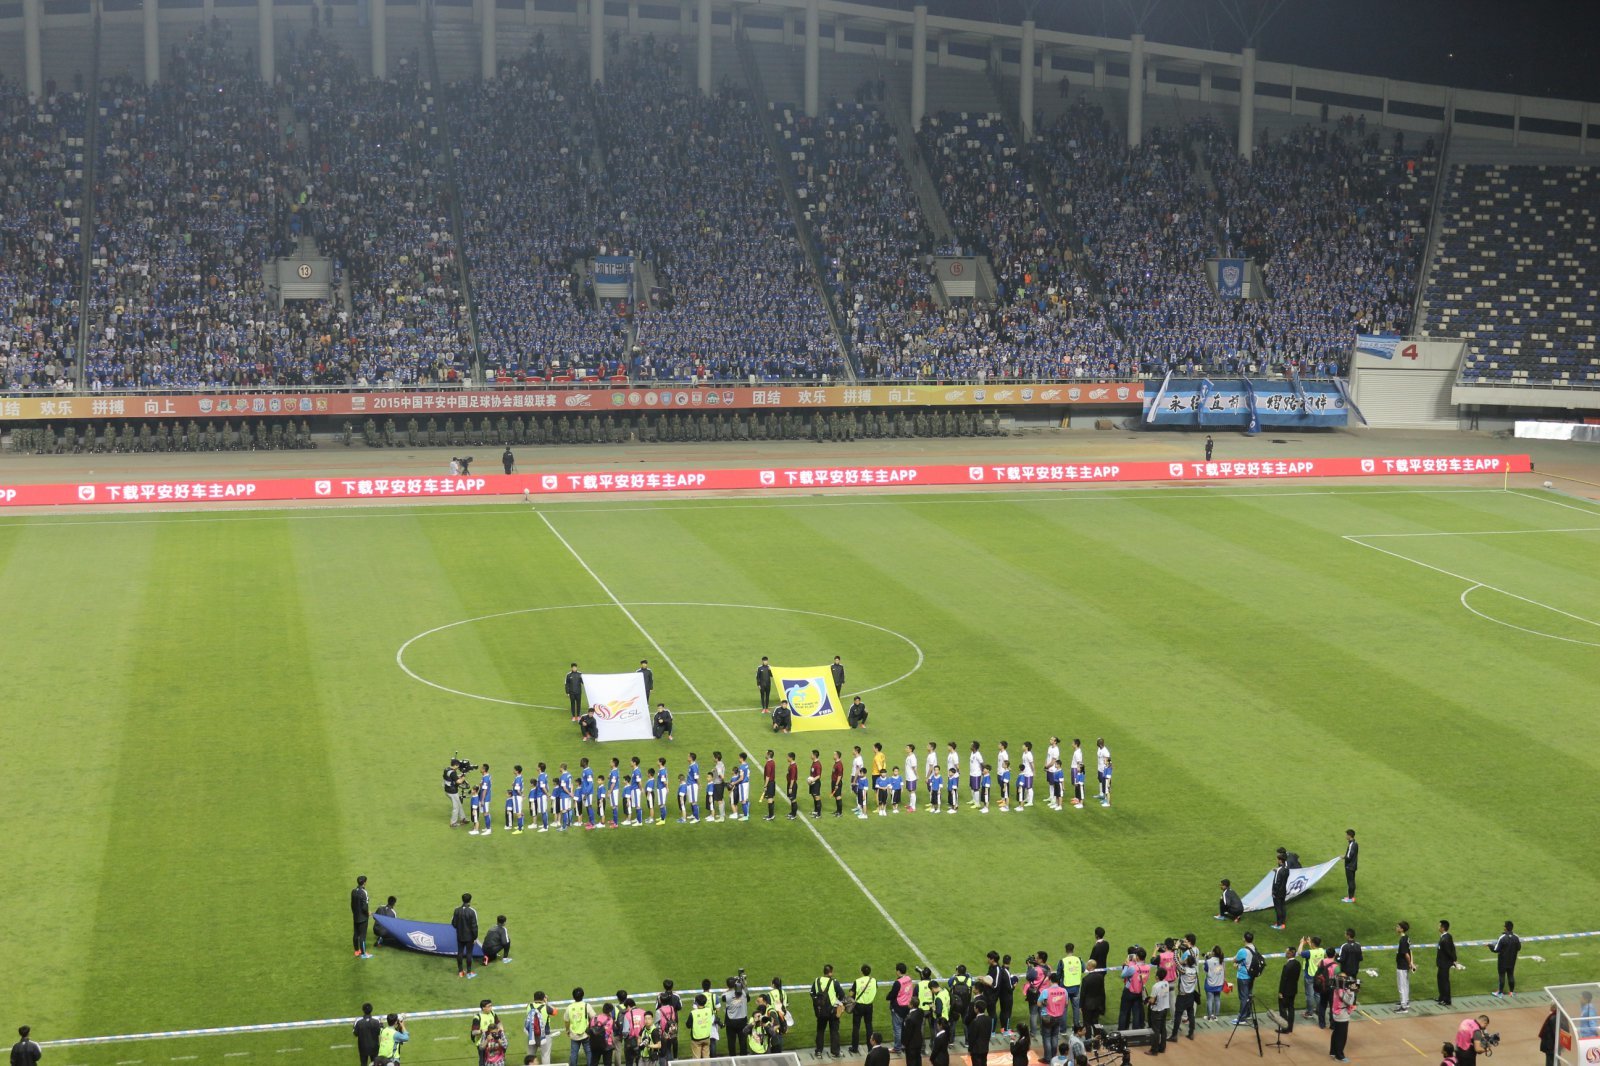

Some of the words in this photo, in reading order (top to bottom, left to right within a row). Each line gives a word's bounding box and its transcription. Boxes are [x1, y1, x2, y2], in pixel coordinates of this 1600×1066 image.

[301, 266, 309, 276] 13
[1402, 344, 1418, 360] 4
[373, 394, 557, 409] 2015中国平安中国足球协会超级联赛
[752, 390, 781, 405] 团结
[798, 389, 826, 404] 欢乐
[843, 389, 871, 404] 拼搏
[888, 388, 916, 403] 向上
[0, 402, 21, 417] 结
[40, 401, 73, 415] 欢乐
[92, 400, 125, 415] 拼搏
[144, 399, 176, 414] 向上
[1192, 462, 1314, 476] 下载平安好车主APP
[1382, 458, 1500, 472] 下载平安好车主APP
[567, 473, 706, 489] 下载平安好车主APP
[784, 469, 917, 485] 下载平安好车主APP
[992, 466, 1120, 481] 下载平安好车主APP
[105, 484, 256, 501] 下载平安好车主APP
[341, 478, 486, 495] 下载平安好车主APP
